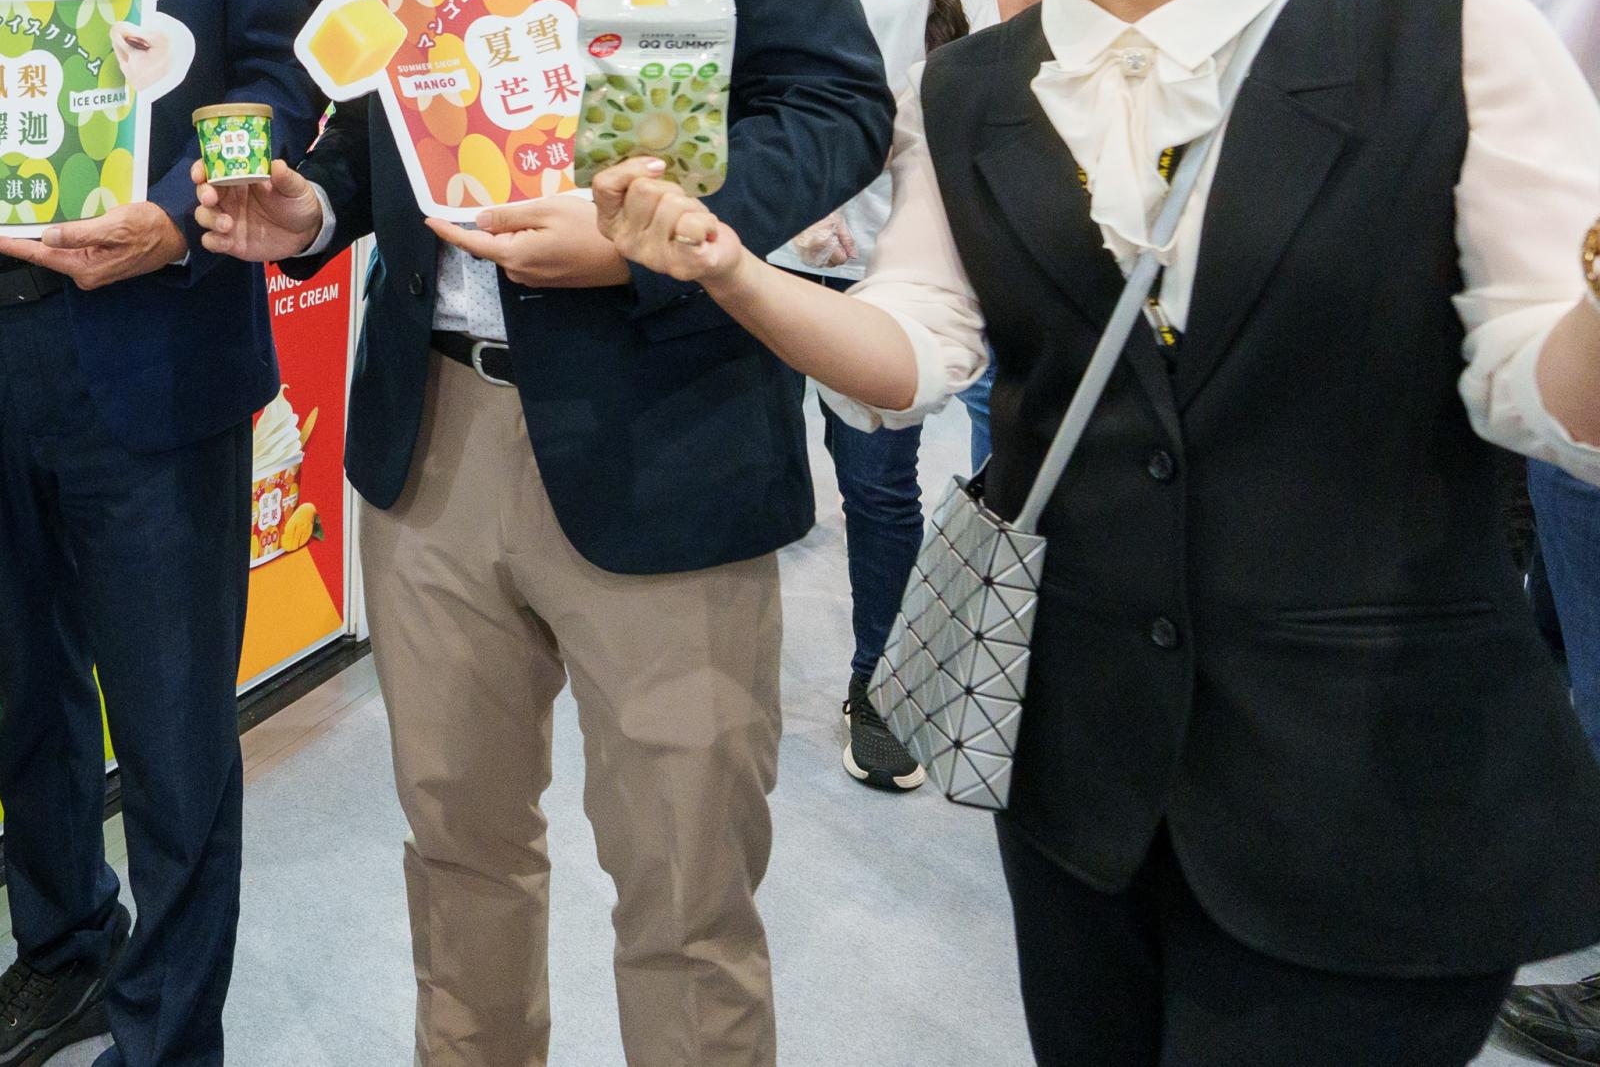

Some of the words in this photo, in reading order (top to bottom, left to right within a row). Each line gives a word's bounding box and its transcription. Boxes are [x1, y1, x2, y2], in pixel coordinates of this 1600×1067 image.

[480, 13, 563, 69] 夏雪
[639, 39, 660, 49] QQ
[664, 39, 719, 51] GUMMY
[397, 61, 432, 73] SUMMER
[414, 77, 456, 92] MANGO
[494, 64, 581, 115] 芒果
[72, 95, 91, 107] ICE
[93, 92, 127, 106] CREAM
[519, 142, 570, 171] 冰淇
[266, 274, 304, 294] ANG
[275, 295, 295, 317] ICE
[300, 283, 339, 309] CREAM
